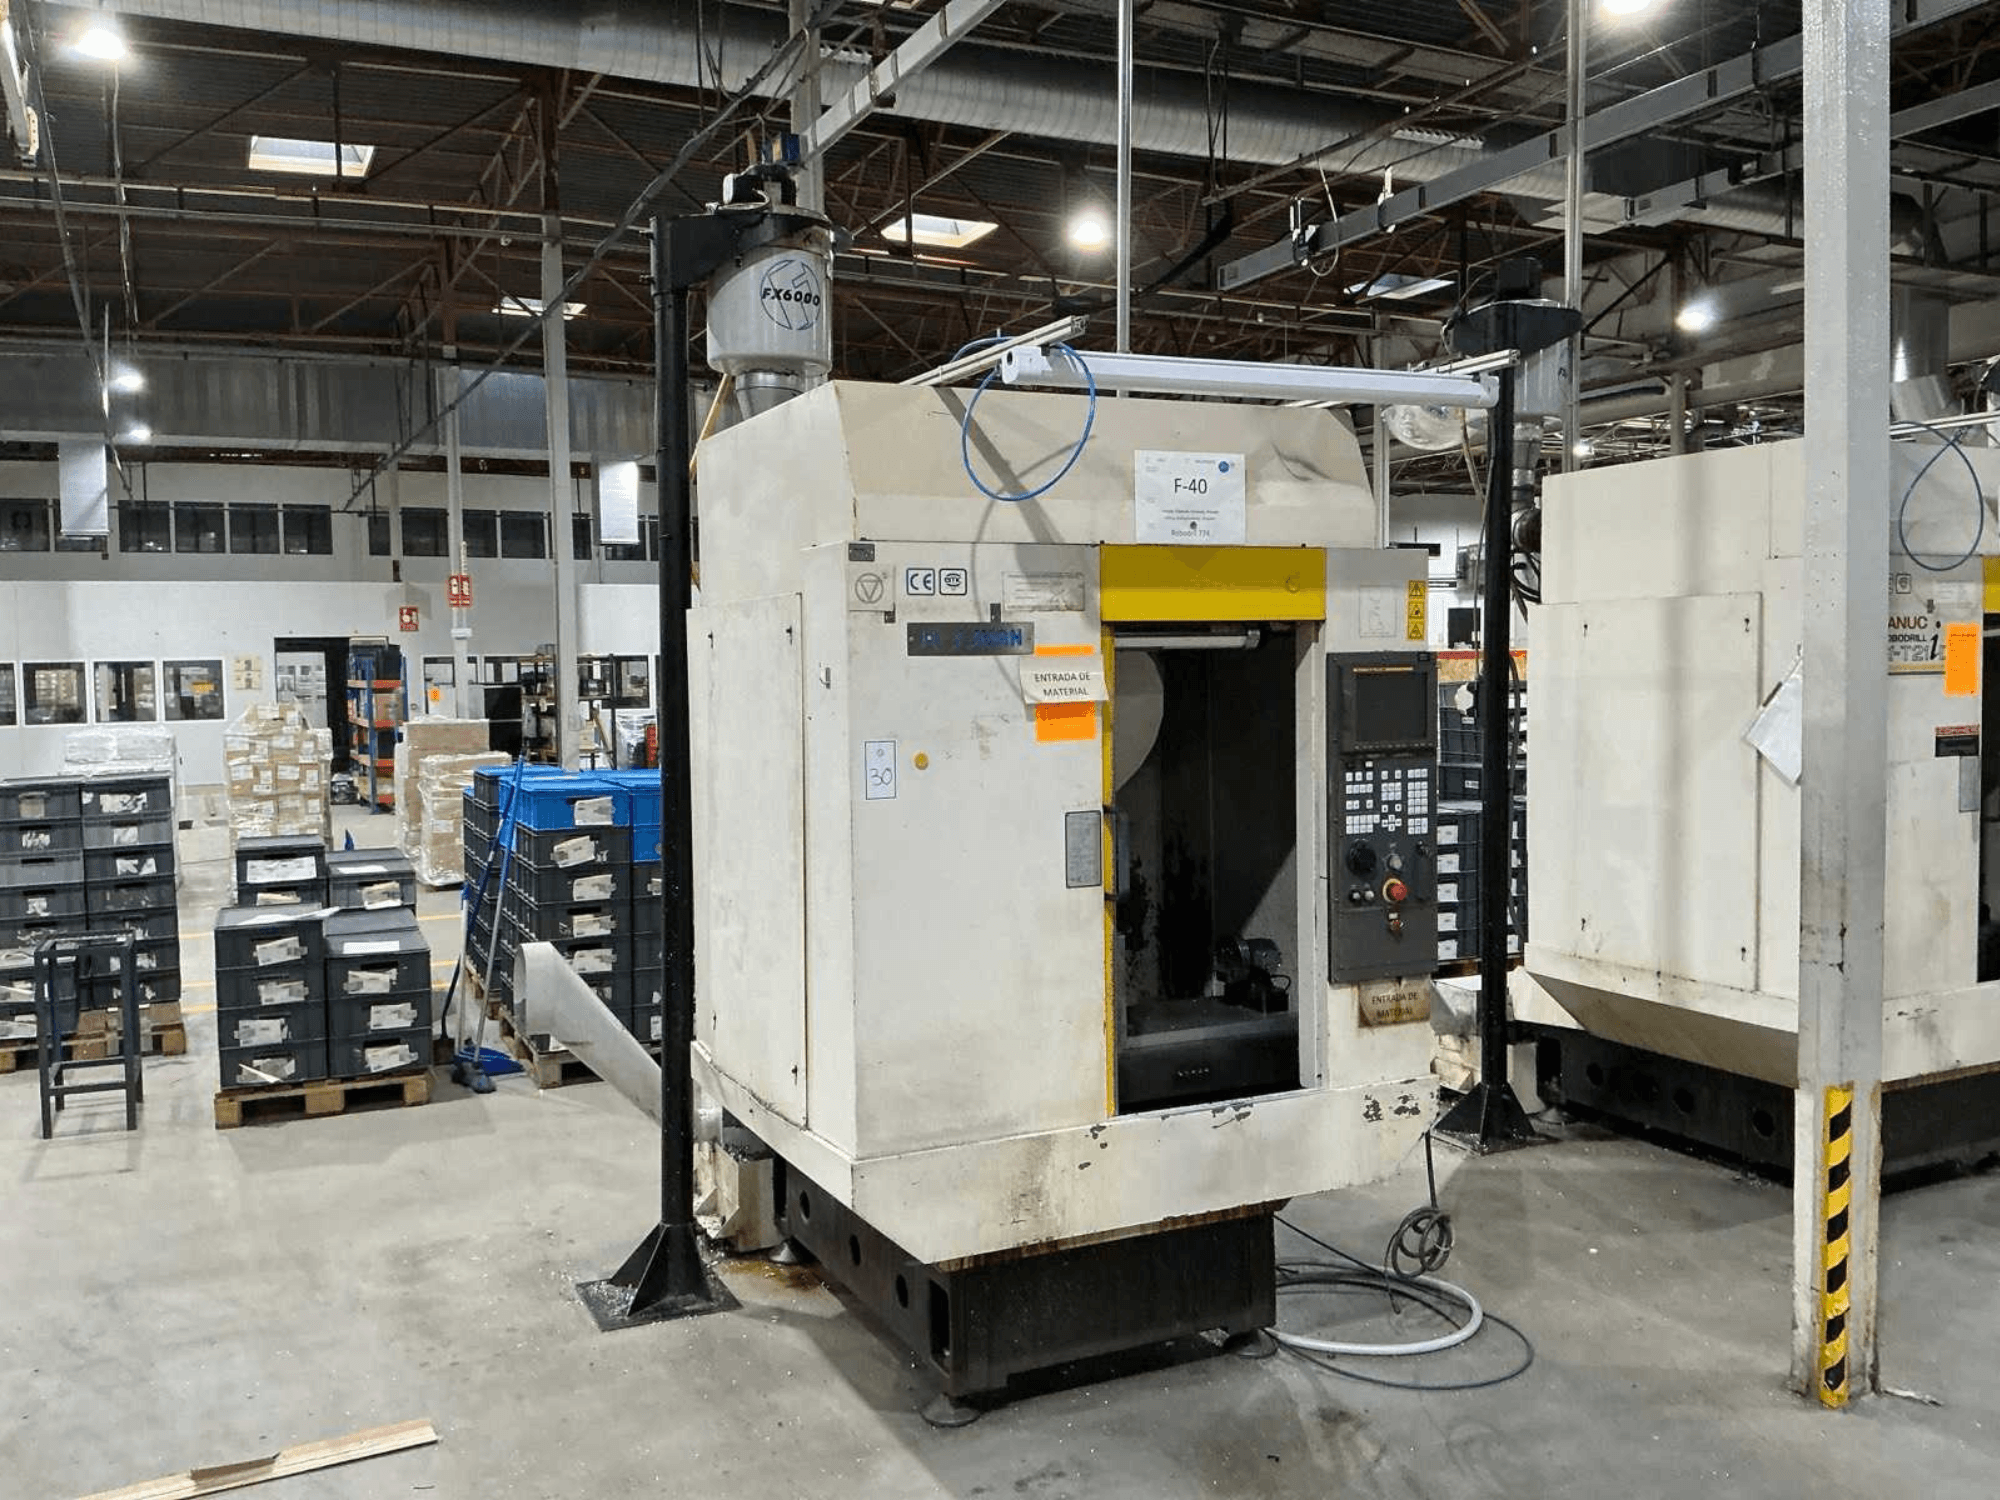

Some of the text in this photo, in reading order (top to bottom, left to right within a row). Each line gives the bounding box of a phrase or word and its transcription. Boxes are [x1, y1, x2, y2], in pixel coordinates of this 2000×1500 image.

[762, 288, 821, 306] FX6000
[1174, 478, 1208, 494] F-40
[1888, 615, 1928, 629] ANUC
[1034, 671, 1091, 682] ENTRADA DE
[1043, 687, 1090, 697] MATERIAL
[869, 767, 893, 785] 30
